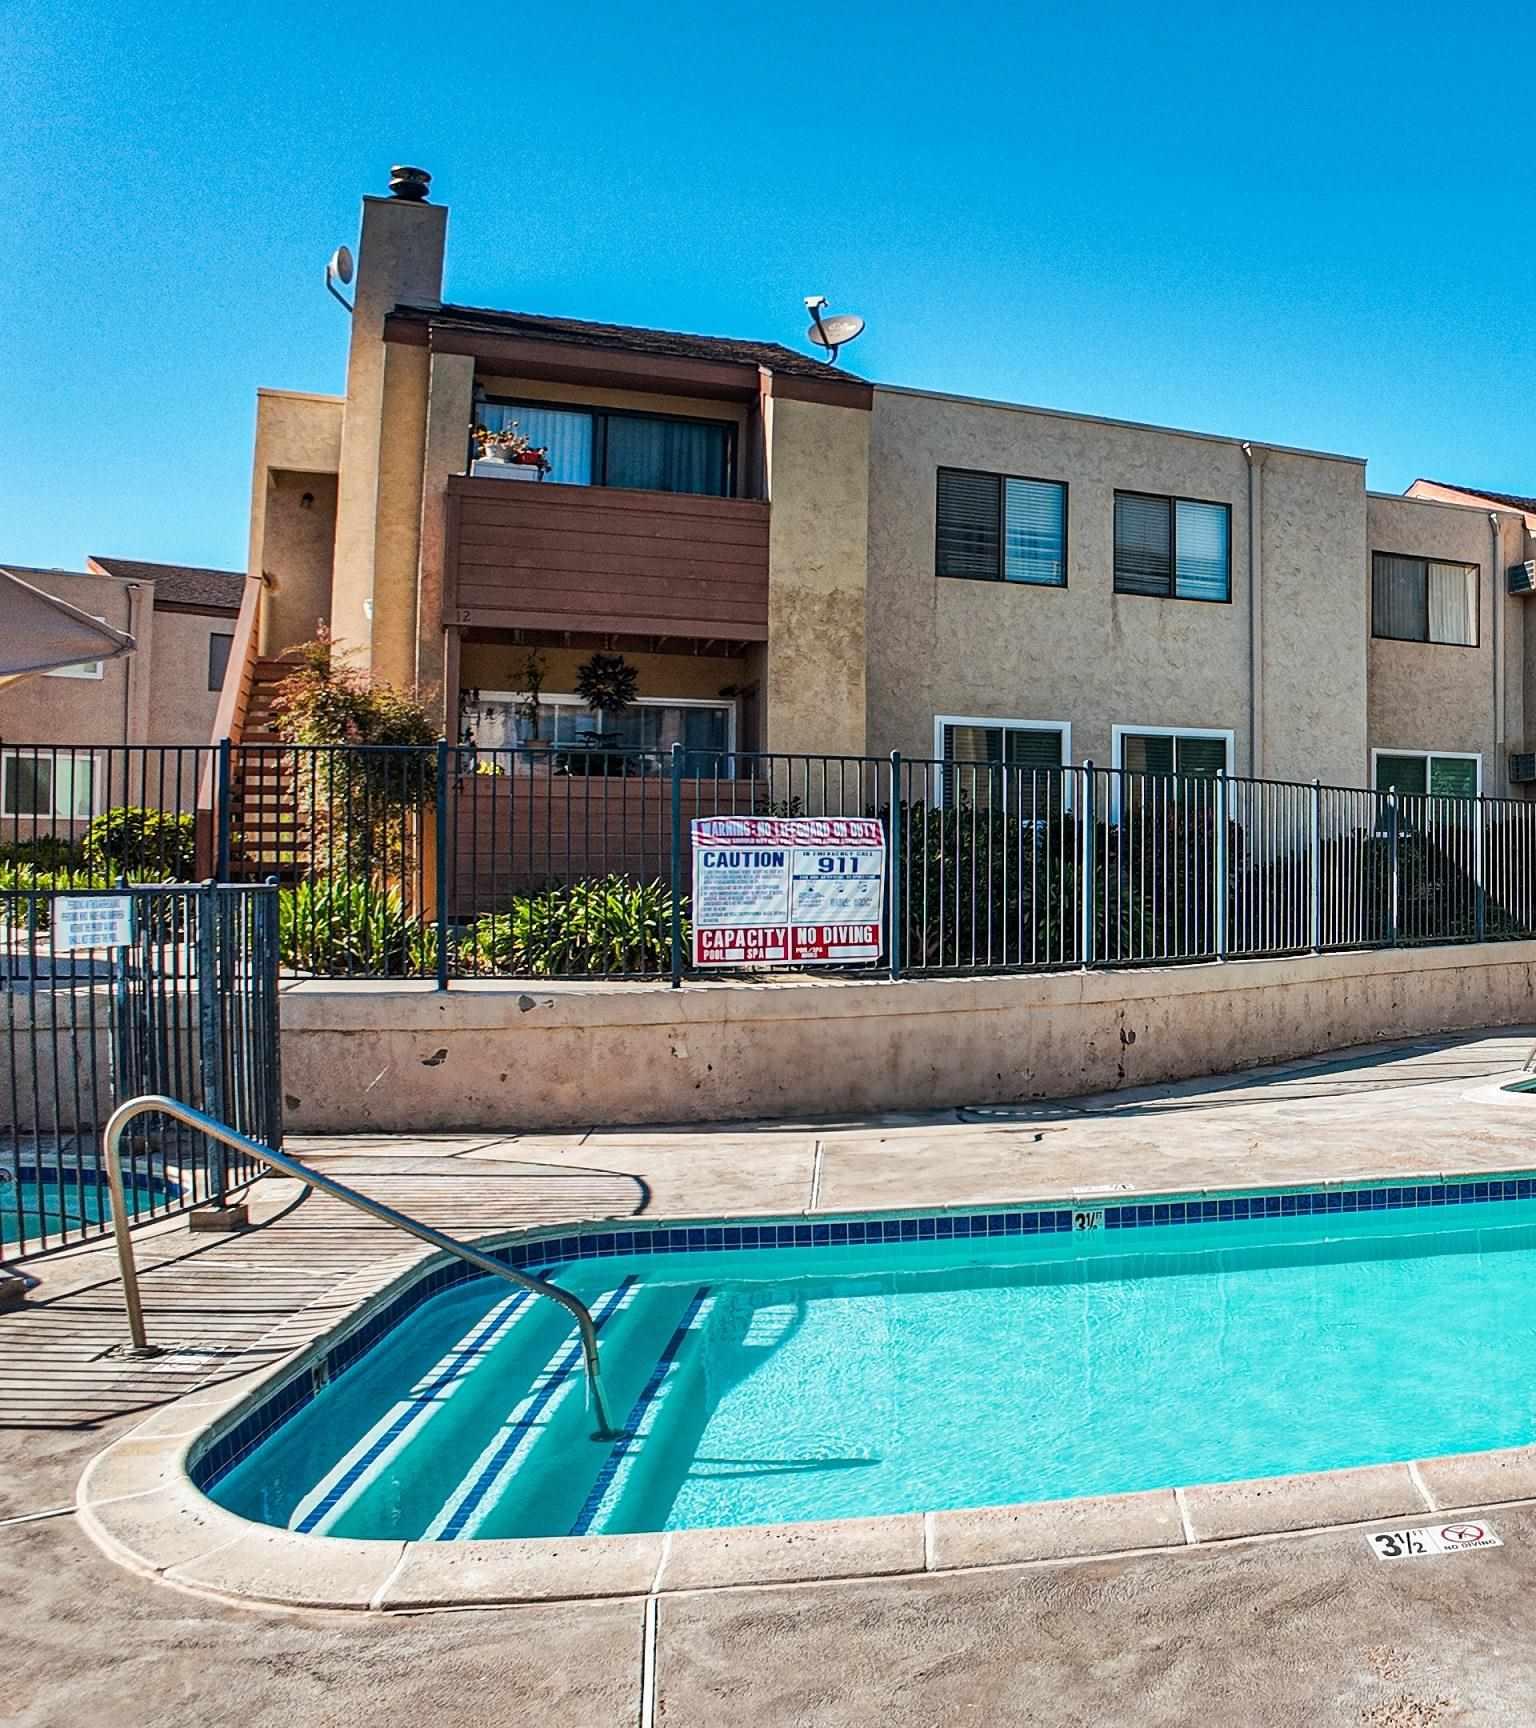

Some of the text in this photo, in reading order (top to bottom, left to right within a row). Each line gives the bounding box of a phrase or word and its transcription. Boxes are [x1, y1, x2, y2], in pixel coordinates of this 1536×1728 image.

[456, 610, 471, 622] 12
[833, 822, 848, 837] ON
[850, 822, 877, 838] DUTY
[703, 851, 785, 868] CAUTION
[818, 856, 859, 873] 911
[702, 928, 786, 949] CAPACITY
[797, 925, 873, 945] NO DIVING
[703, 948, 765, 960] POOL SPA
[1462, 1539, 1497, 1549] DIVING
